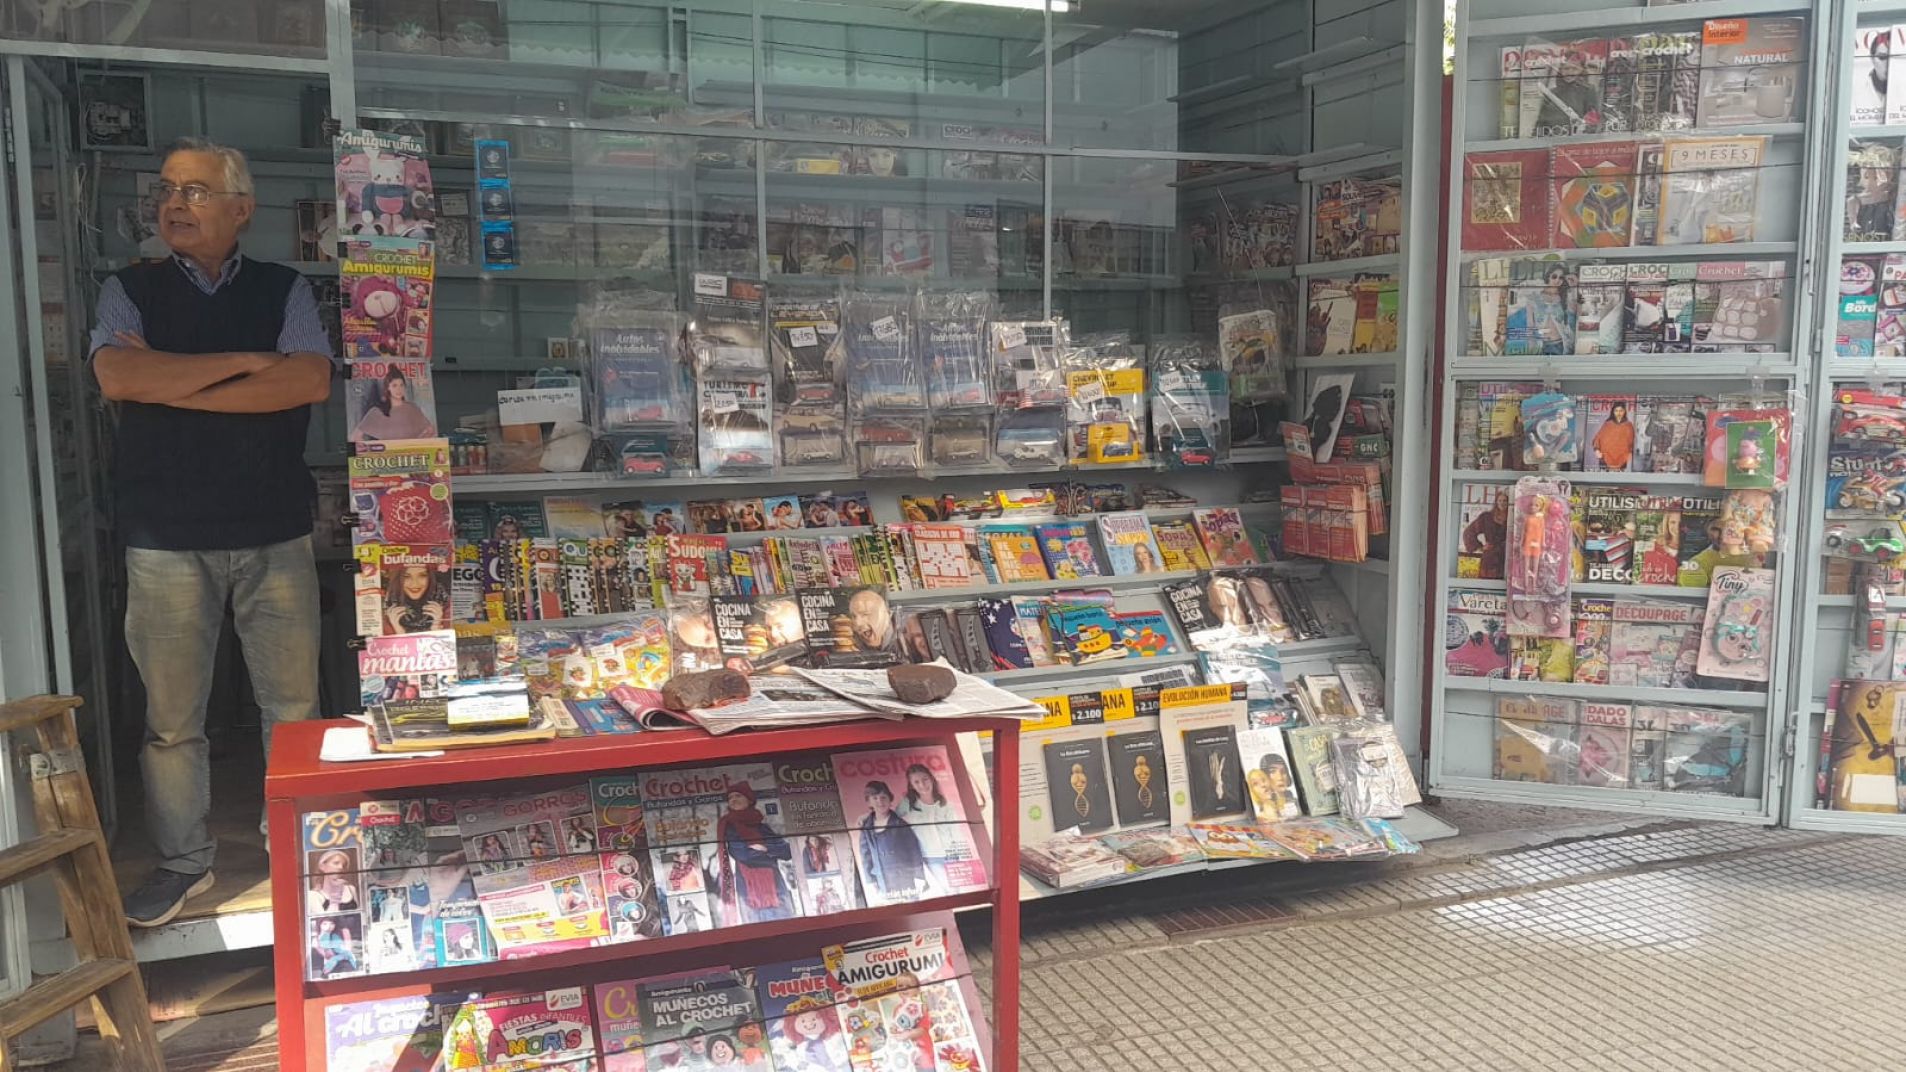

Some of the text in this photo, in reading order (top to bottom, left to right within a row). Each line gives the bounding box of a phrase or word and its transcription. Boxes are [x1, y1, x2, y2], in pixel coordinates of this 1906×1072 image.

[1734, 52, 1789, 64] NATURAL
[340, 131, 423, 155] Amigurumis
[1695, 148, 1749, 161] MESES
[374, 253, 417, 264] CROCHET
[342, 262, 431, 277] Amigurumis
[351, 361, 427, 380] CROHET
[353, 454, 431, 470] CROCHET
[383, 553, 447, 566] bufandas
[1169, 585, 1204, 603] COCINA
[801, 595, 836, 608] COCINA
[1175, 600, 1190, 612] EN
[715, 602, 753, 617] COCINA
[803, 607, 817, 620] EN
[1180, 609, 1204, 624] CASA
[717, 615, 730, 628] EN
[806, 619, 831, 633] CASA
[719, 627, 745, 641] CASA
[1200, 686, 1228, 700] HUMANA
[1587, 705, 1627, 716] DADO
[1586, 714, 1627, 726] DALAS
[865, 945, 911, 965] Crochet
[837, 951, 945, 987] AMIGURUMI
[653, 991, 729, 1014] MUÑECOS
[656, 1001, 753, 1027] AL CROCHET
[498, 1013, 539, 1031] FIESTAS
